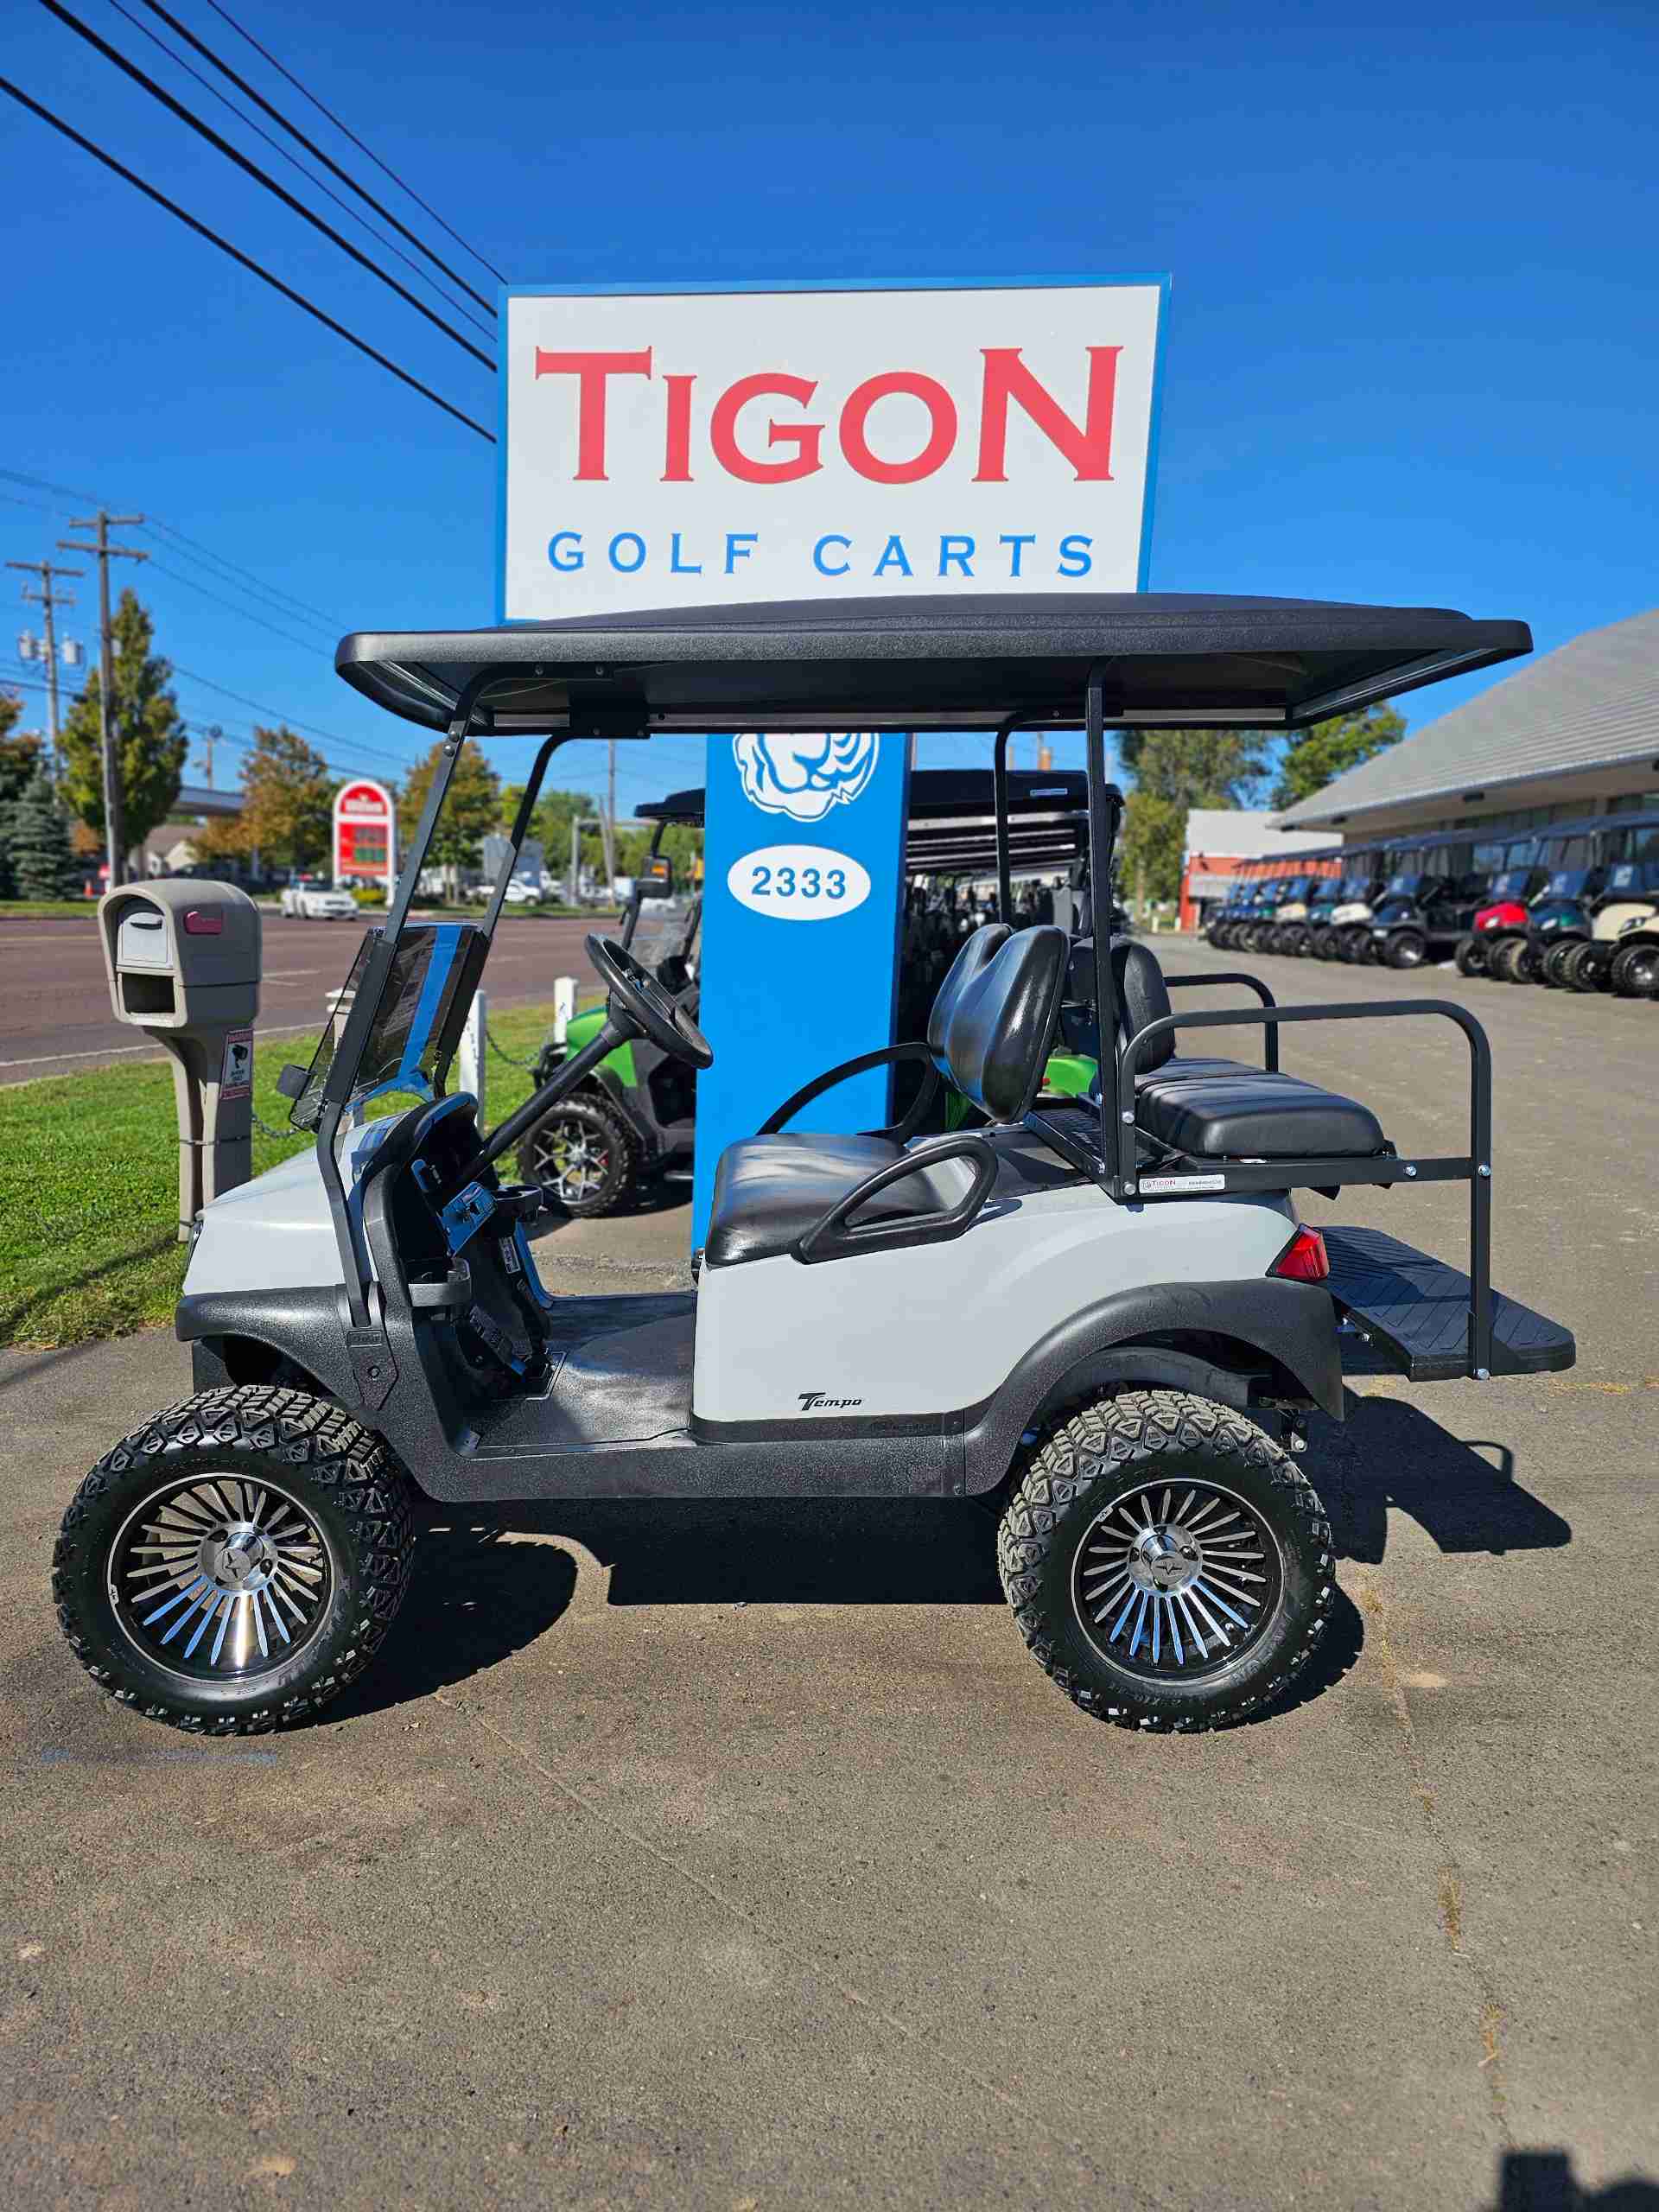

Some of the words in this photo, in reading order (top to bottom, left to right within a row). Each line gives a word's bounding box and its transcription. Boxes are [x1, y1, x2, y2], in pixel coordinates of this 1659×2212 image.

[536, 345, 1125, 485] TIGON
[547, 531, 760, 575] GOLF
[812, 532, 1094, 578] CARTS
[751, 865, 847, 899] 2333
[798, 1392, 862, 1411] Tempo
